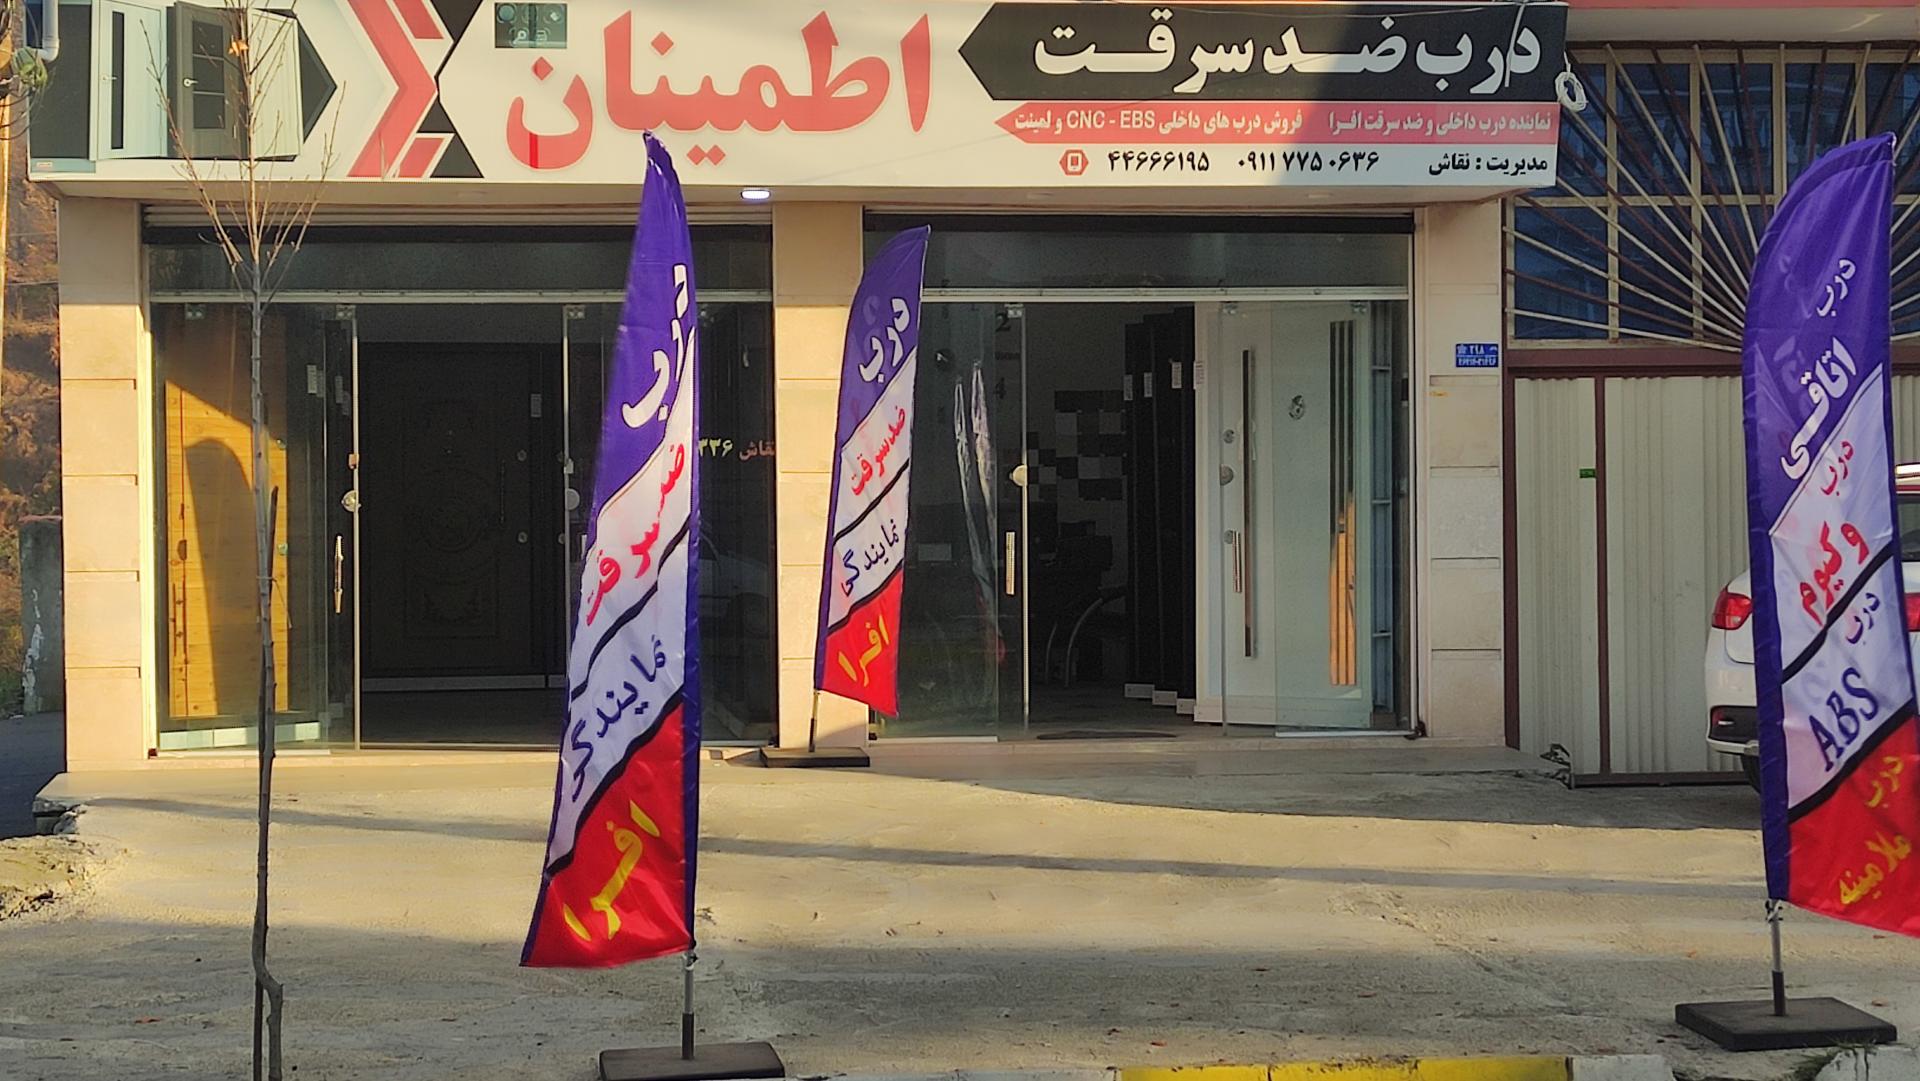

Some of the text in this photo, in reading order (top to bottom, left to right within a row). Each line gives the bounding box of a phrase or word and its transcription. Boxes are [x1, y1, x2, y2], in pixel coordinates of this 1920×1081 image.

[1032, 6, 1541, 95] درب ضد سرقت
[505, 9, 931, 170] اطمینان
[1014, 109, 1052, 135] لمینت
[1066, 110, 1105, 129] CNC
[1120, 110, 1155, 129] EBS
[1158, 111, 1201, 136] داخلی
[1203, 112, 1231, 136] های
[1231, 112, 1262, 136] درب
[1263, 109, 1303, 136] فروش
[1363, 109, 1401, 136] سرقت
[1401, 112, 1424, 132] ضد
[1435, 111, 1476, 137] داخلی
[1478, 112, 1507, 136] درب
[1508, 111, 1552, 136] نماینده
[1108, 151, 1210, 172] ۴۴۶۶۶۱۹۵
[1238, 151, 1380, 172] ۰۹۱۱ ۷۷۵ ۰۶۳۶
[1428, 151, 1471, 177] نقاش
[1486, 154, 1548, 177] مدیریت
[1815, 258, 1856, 318] درب
[621, 263, 688, 429] درب
[857, 297, 911, 384] درب
[1780, 336, 1857, 480] اتاقی
[1820, 440, 1854, 496] درب
[840, 518, 900, 597] نمایندگی
[1845, 592, 1881, 646] درب
[838, 614, 890, 688] افرا
[569, 634, 667, 803] نمایندگی
[1808, 667, 1879, 773] ABS
[1864, 756, 1904, 808] درب
[563, 799, 661, 941] افرا
[1839, 831, 1912, 905] ملامینه
